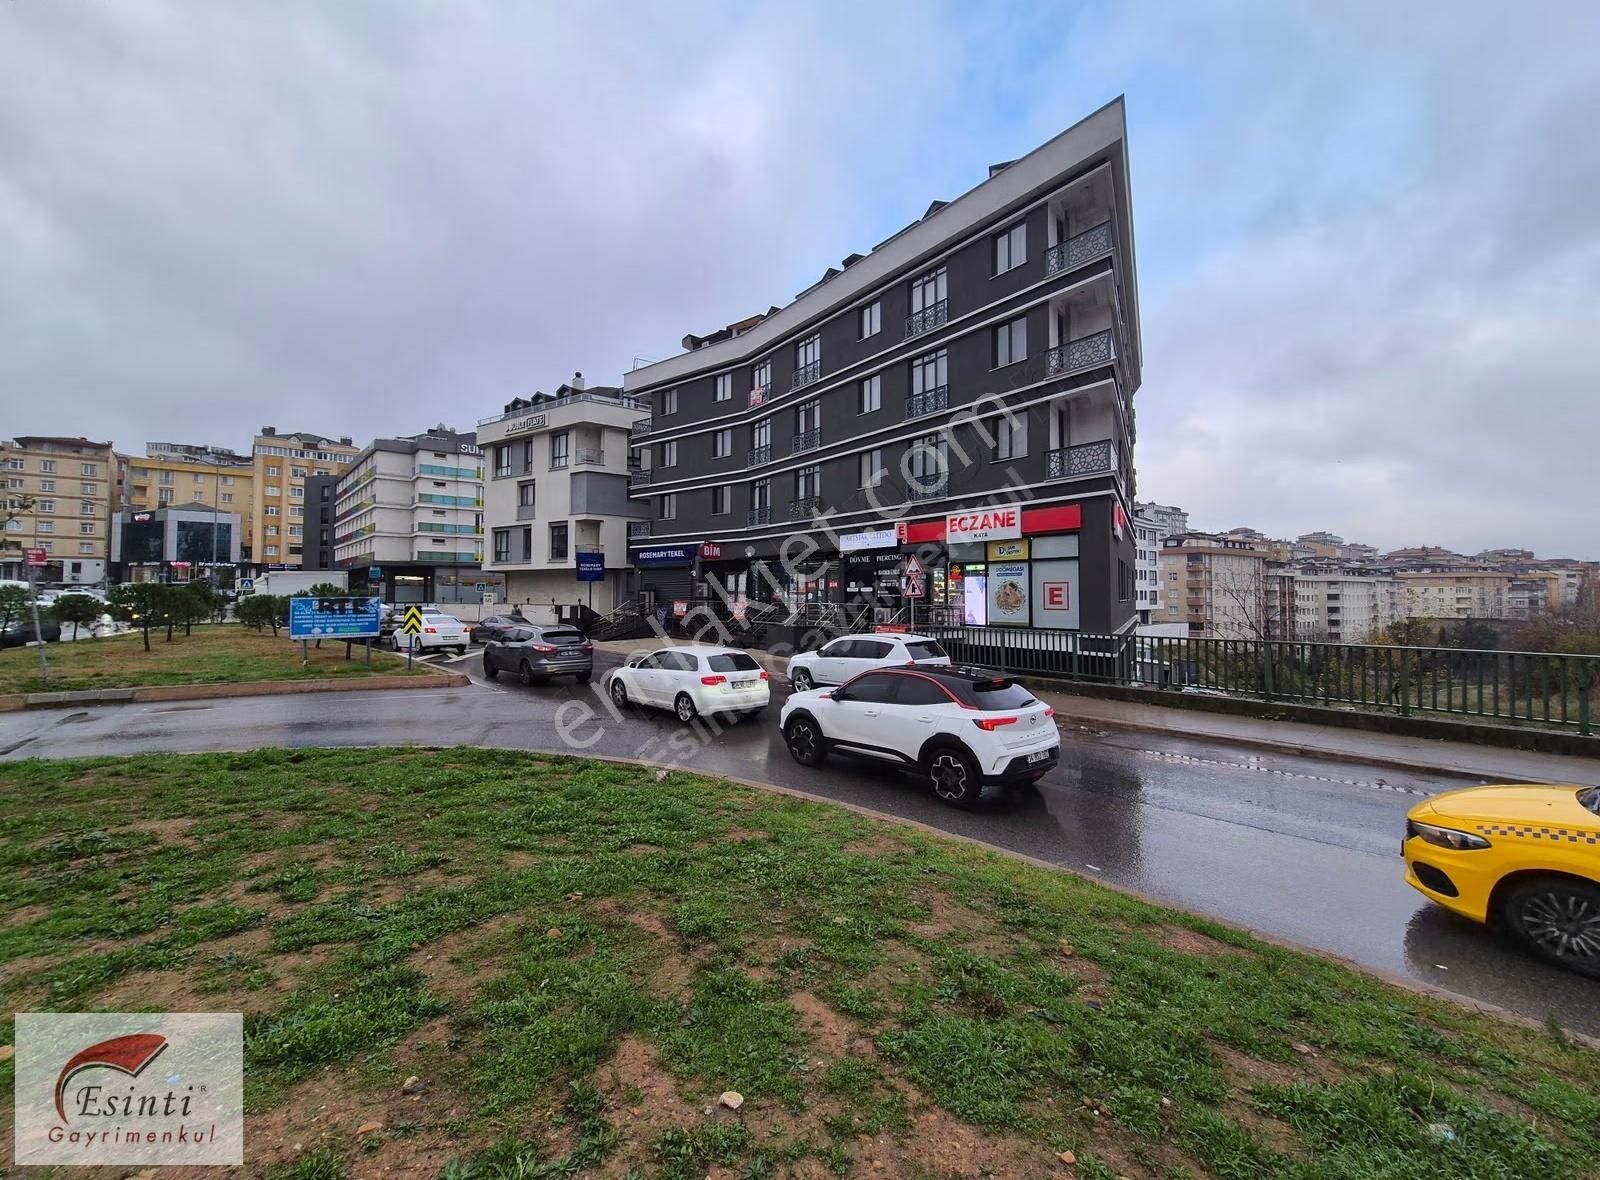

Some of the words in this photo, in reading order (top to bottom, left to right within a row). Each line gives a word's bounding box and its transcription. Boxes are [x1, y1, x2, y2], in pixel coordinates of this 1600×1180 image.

[949, 511, 1016, 533] ECZANE
[898, 526, 905, 536] E
[639, 551, 667, 559] ROSEMARY
[667, 550, 685, 558] TEKEL
[703, 543, 721, 557] BİM
[849, 554, 871, 563] DÖVME
[876, 554, 902, 562] PIERCING
[1048, 587, 1063, 605] E
